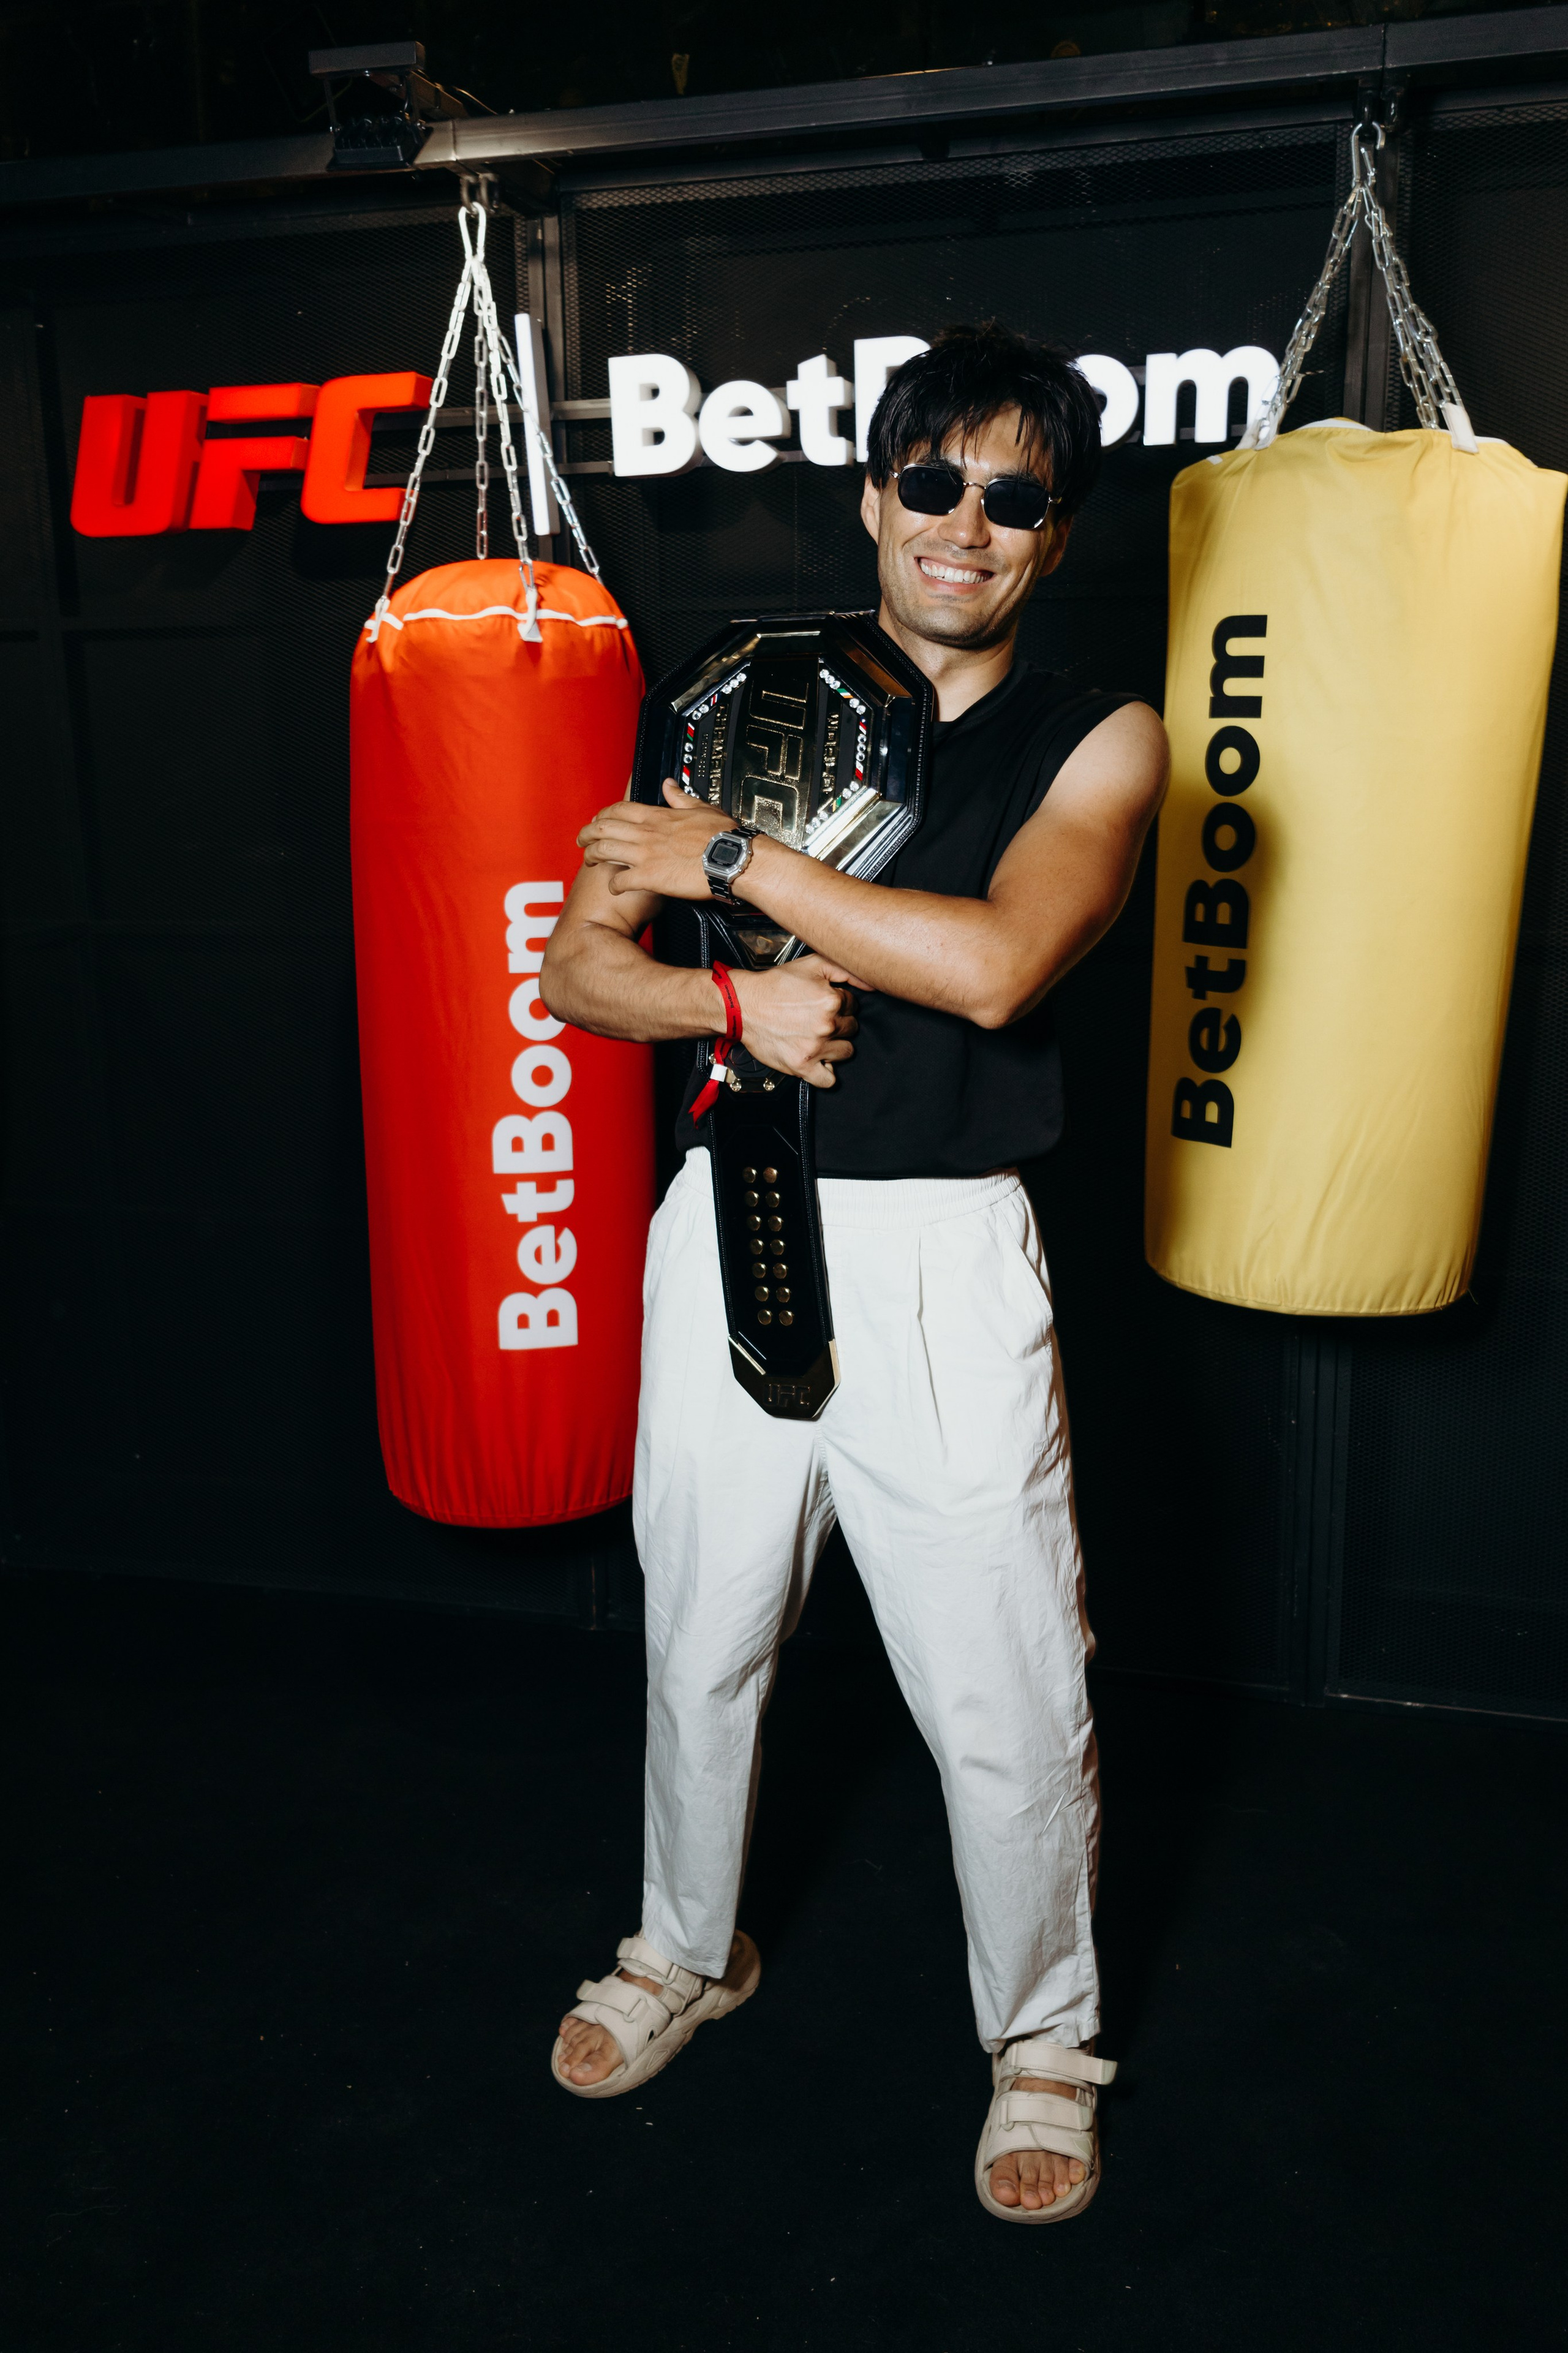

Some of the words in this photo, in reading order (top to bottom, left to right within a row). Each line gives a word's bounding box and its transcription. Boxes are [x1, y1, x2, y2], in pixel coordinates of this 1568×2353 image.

[69, 371, 435, 538] UFC
[740, 674, 809, 832] UFC
[1170, 614, 1268, 1149] BetBoom
[491, 880, 579, 1350] BetBoom
[763, 1383, 812, 1408] UFC
